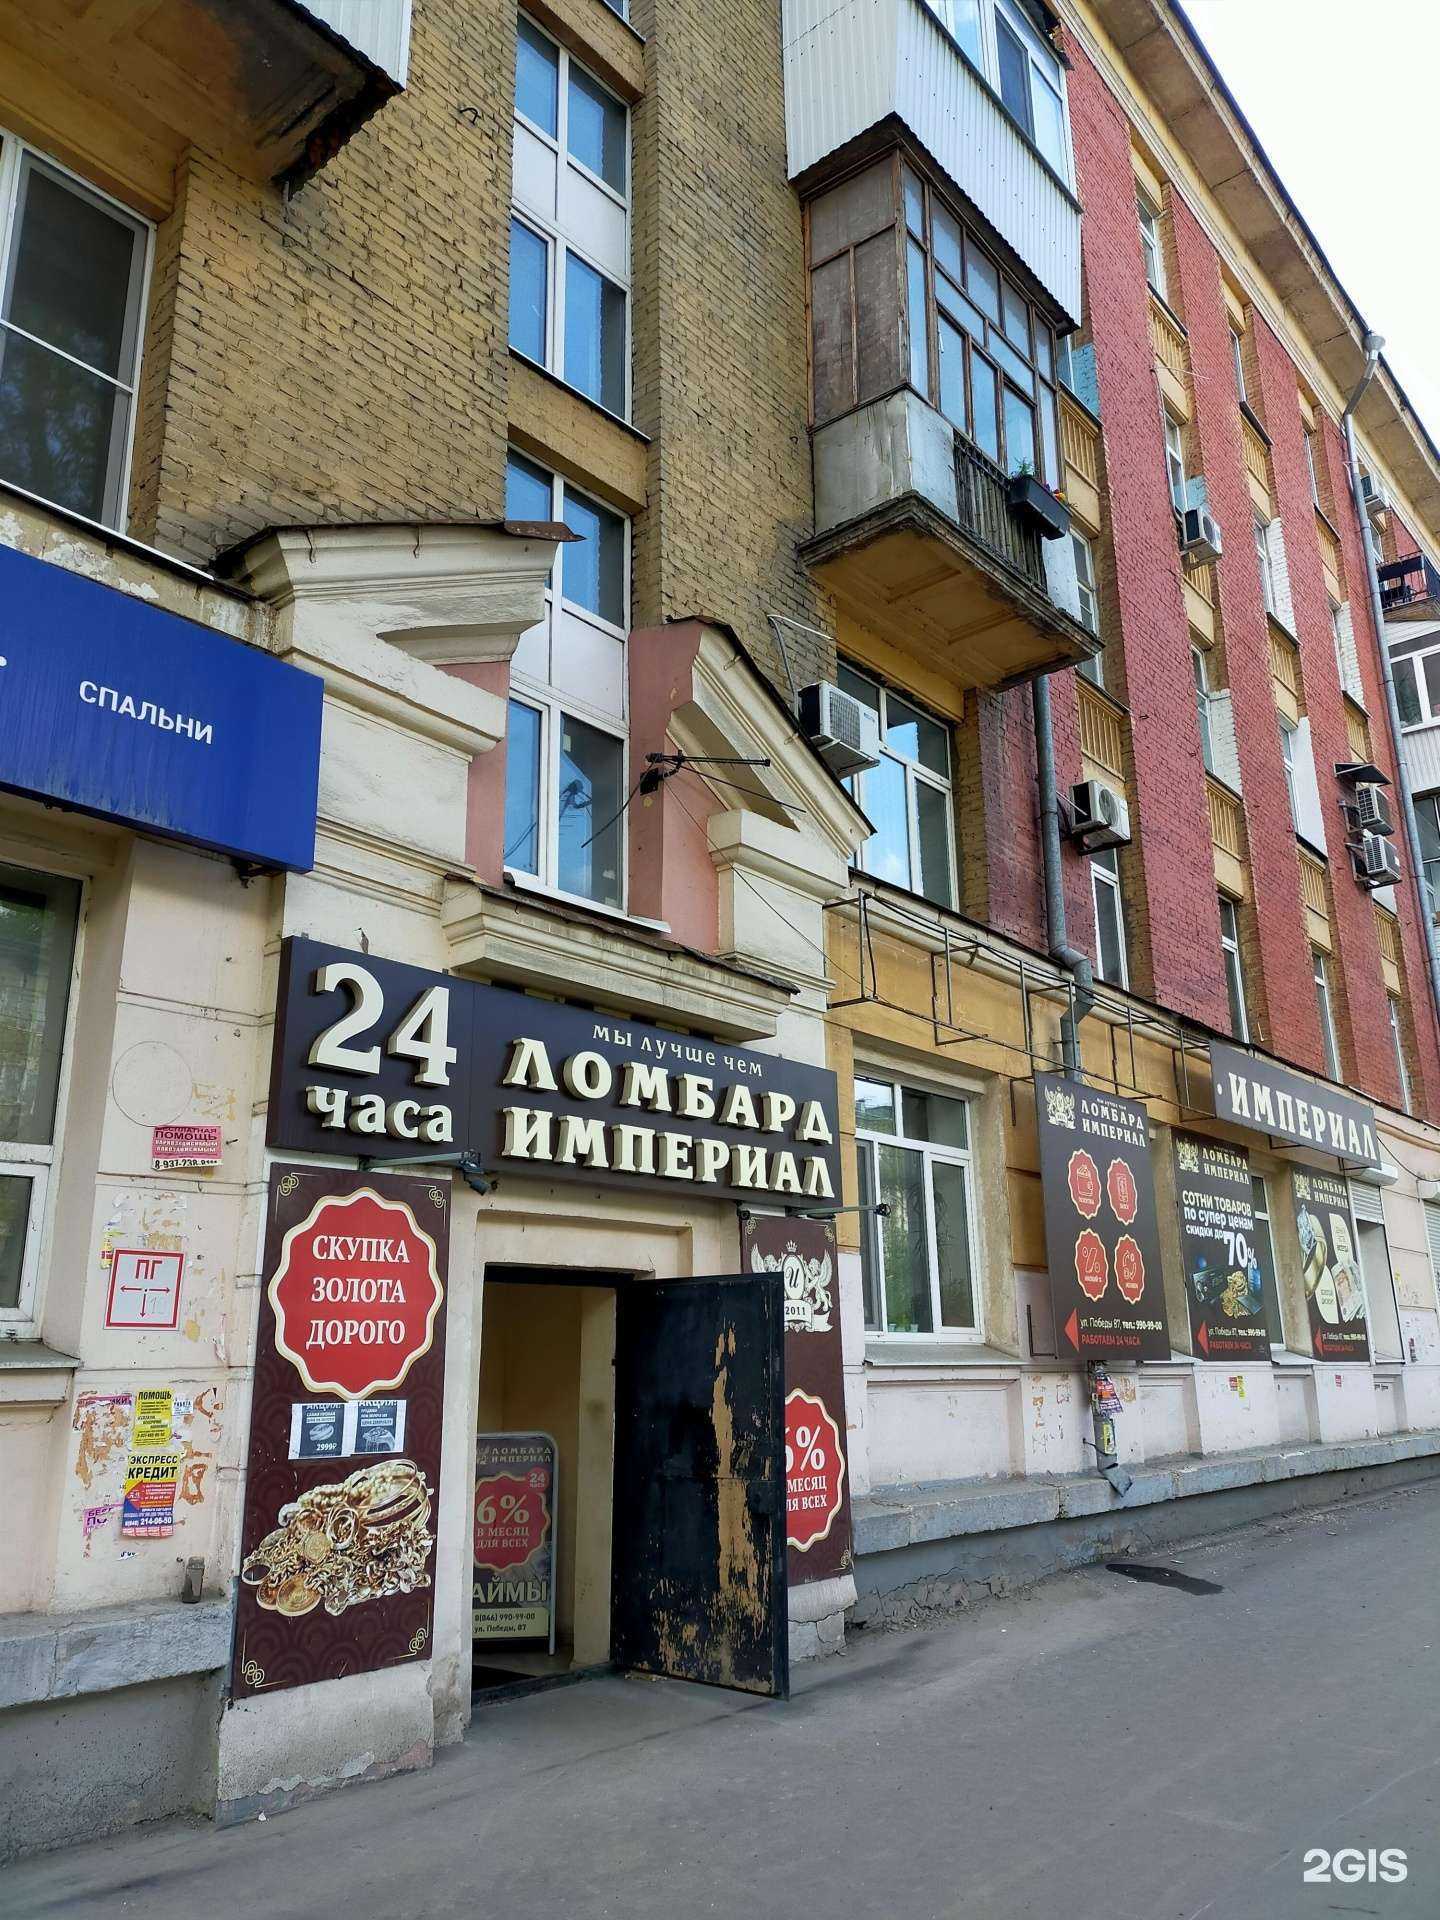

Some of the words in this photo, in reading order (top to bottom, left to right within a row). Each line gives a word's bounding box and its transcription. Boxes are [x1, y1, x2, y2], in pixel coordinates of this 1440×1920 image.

[79, 680, 213, 745] СПАЛЬНИ
[308, 962, 457, 1086] 24
[592, 1022, 632, 1047] мы
[640, 1035, 716, 1066] лучше
[723, 1053, 763, 1078] чем
[503, 1037, 833, 1145] ЛОМБАРД
[306, 1085, 454, 1142] часа
[1081, 1099, 1144, 1131] ЛОМБАРД
[1229, 1072, 1377, 1160] ИМПЕРИАЛ
[155, 1131, 218, 1142] ПОМОЩЬ
[1082, 1118, 1146, 1148] ИМПЕРИАЛ
[502, 1106, 835, 1199] ИМПЕРИАЛ
[1202, 1147, 1248, 1170] ЛОМБАРД
[1204, 1163, 1249, 1185] ИМПЕРИАЛ
[1183, 1190, 1213, 1209] СОТНИ
[1214, 1196, 1251, 1216] ТОВАРОВ
[1199, 1209, 1227, 1228] супер
[1228, 1215, 1254, 1231] ценам
[312, 1234, 410, 1264] СКУПКА
[135, 1260, 163, 1280] ПГ
[311, 1276, 406, 1303] ЗОЛОТА
[785, 1306, 806, 1316] 2011
[1089, 1317, 1113, 1329] Победы
[305, 1319, 406, 1350] ДОРОГО
[138, 1391, 172, 1400] ПОМОЩЬ
[130, 1455, 178, 1465] ЭКСПРЕСС
[491, 1455, 551, 1463] ИМПЕРИАЛ
[492, 1447, 552, 1455] ЛОМБАРД
[128, 1466, 177, 1480] КРЕДИТ
[529, 1473, 545, 1483] 24
[787, 1475, 828, 1493] МЕСЯЦ
[476, 1494, 530, 1524] 6%
[802, 1494, 828, 1510] ВСЕХ
[489, 1527, 530, 1537] МЕСЯЦ
[502, 1538, 528, 1548] ВСЕХ
[473, 1575, 547, 1603] АЙМЫ
